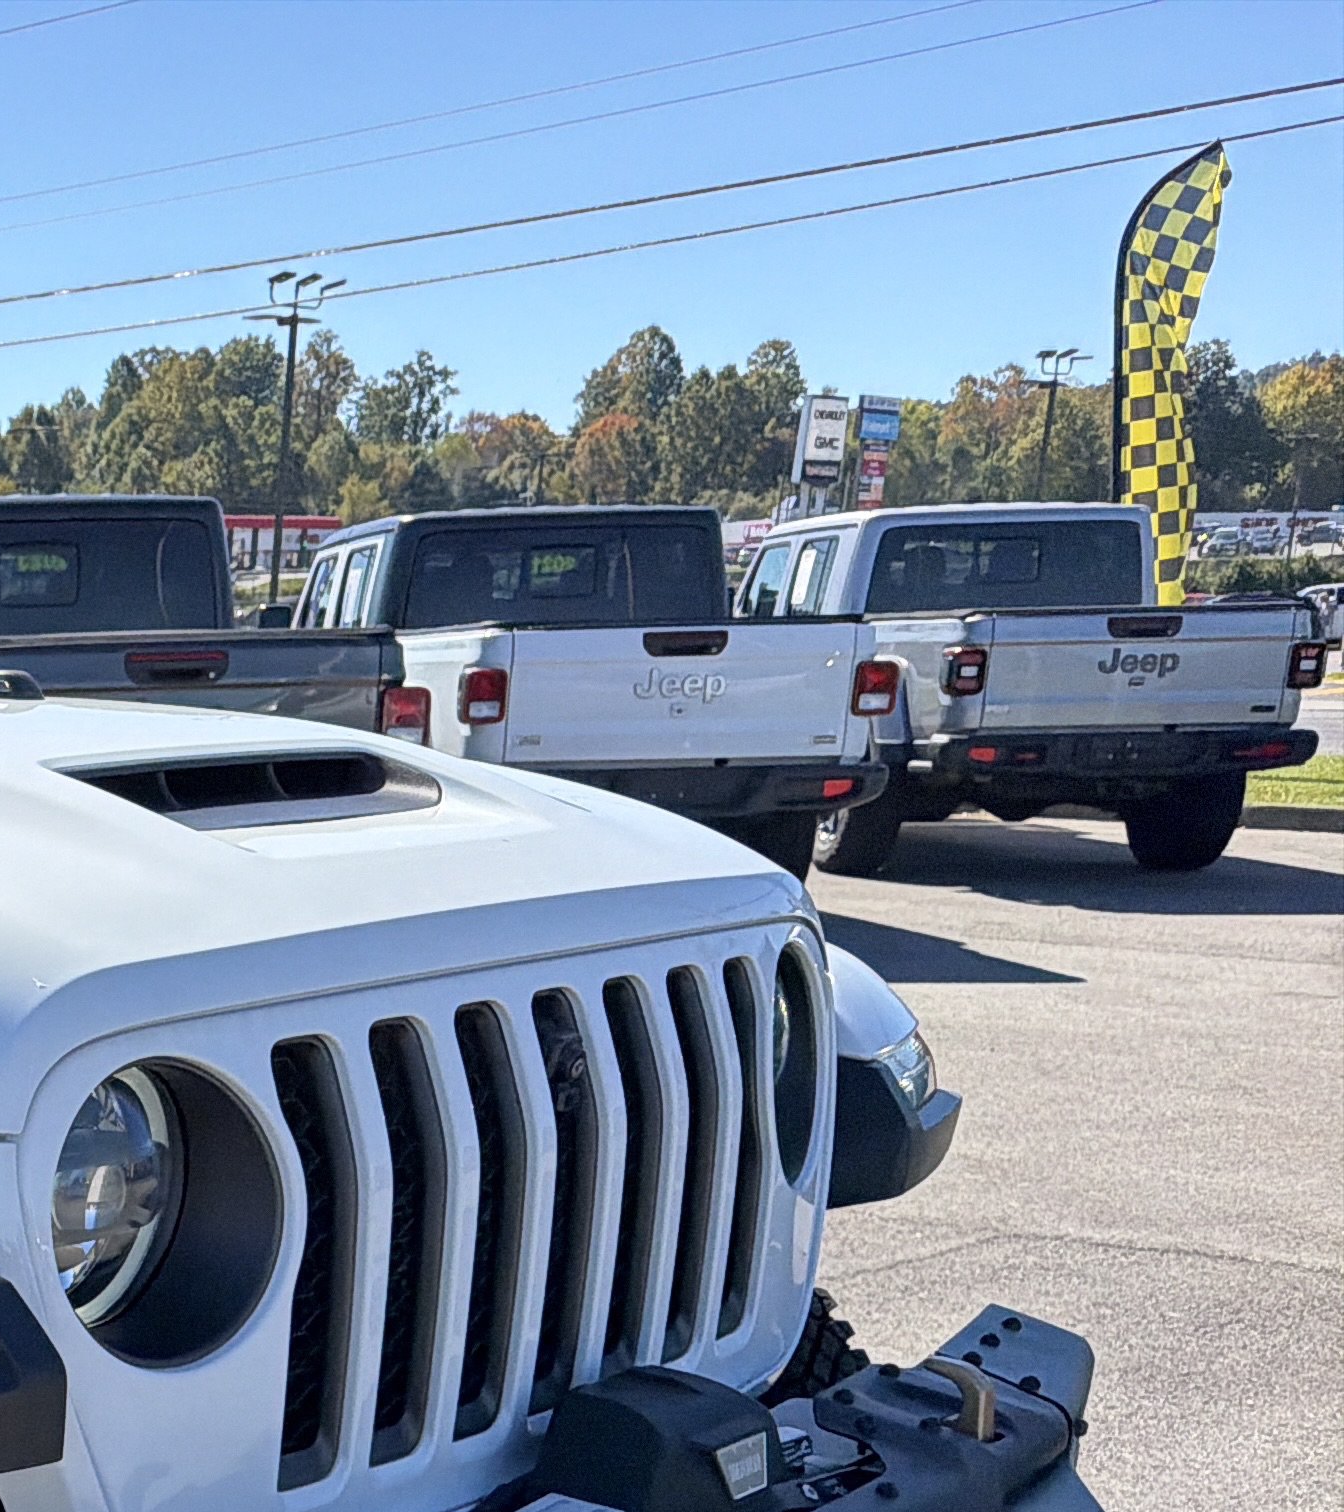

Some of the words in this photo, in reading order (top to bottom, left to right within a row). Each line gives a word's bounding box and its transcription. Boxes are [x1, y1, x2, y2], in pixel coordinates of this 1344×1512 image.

[814, 436, 841, 451] GMC
[1097, 648, 1181, 678] Jeep
[632, 667, 727, 704] Jeep
